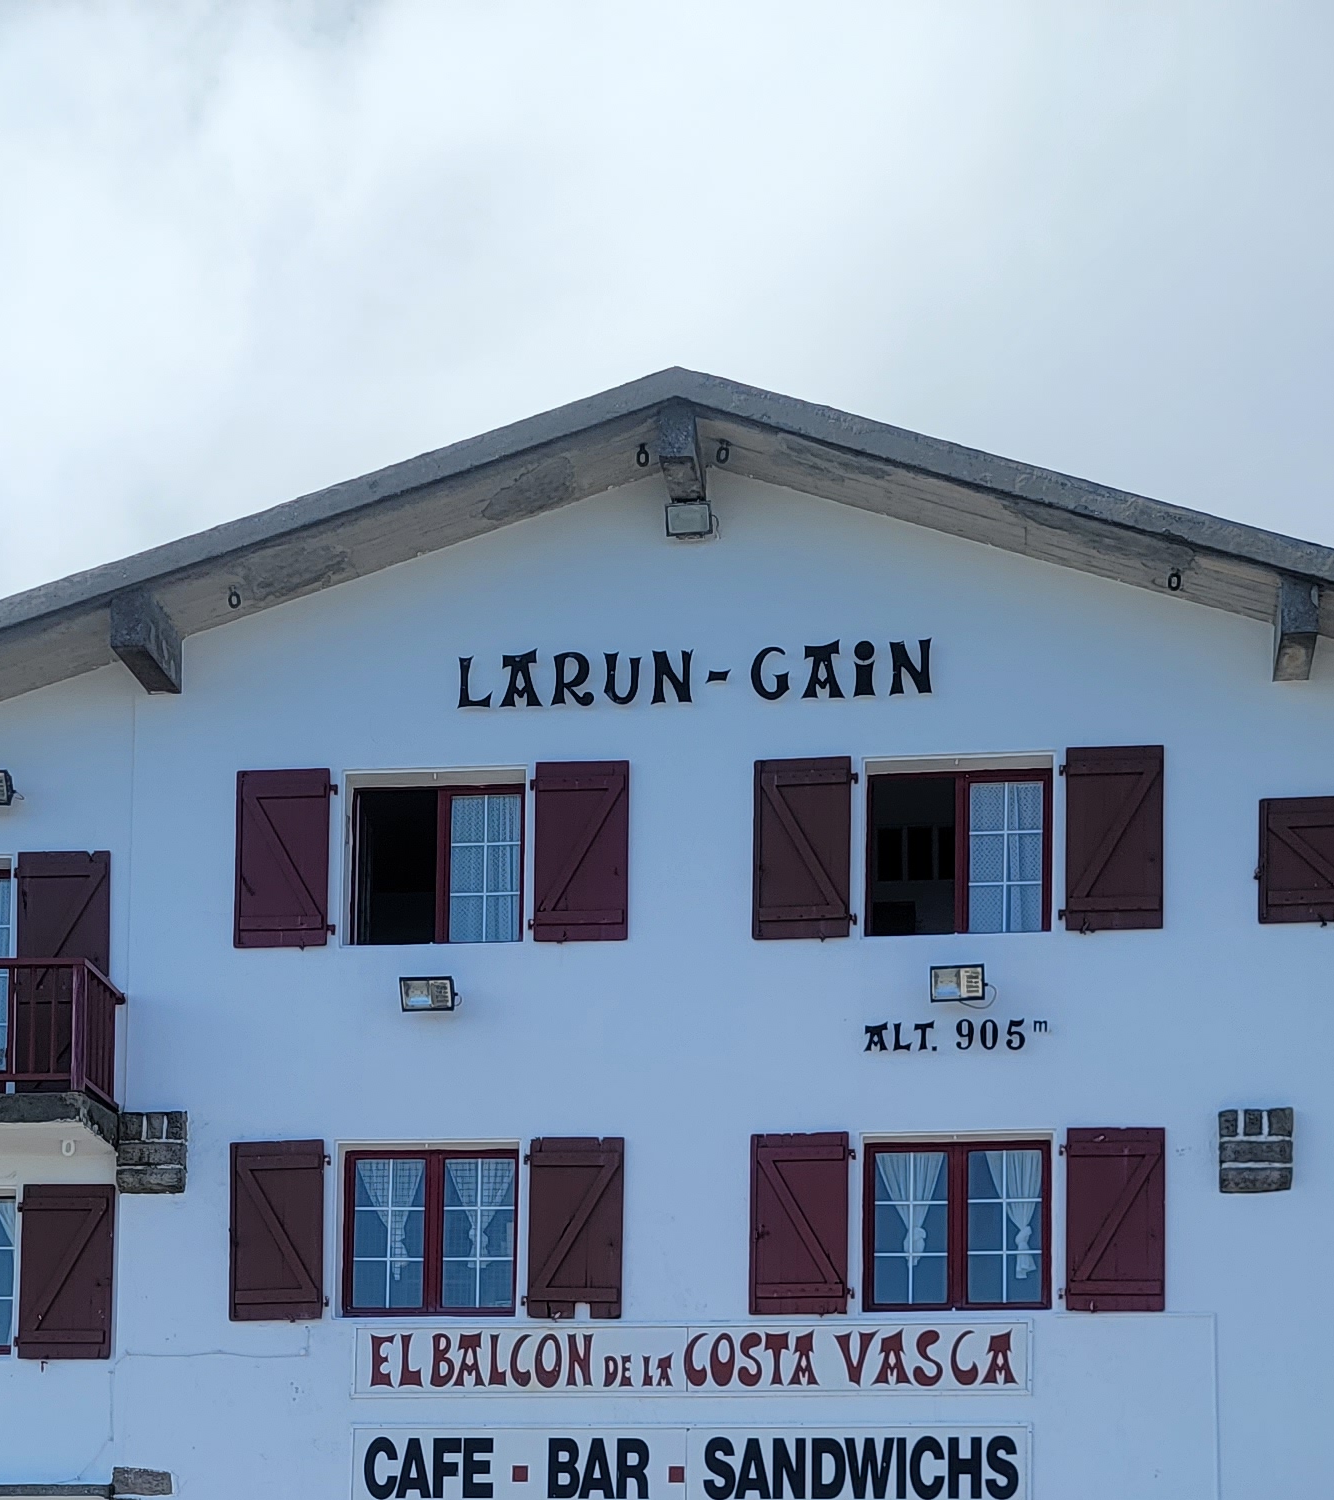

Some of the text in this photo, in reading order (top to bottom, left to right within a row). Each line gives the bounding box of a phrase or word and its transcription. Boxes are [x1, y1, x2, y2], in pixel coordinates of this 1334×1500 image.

[865, 1021, 937, 1051] ALT.
[370, 1327, 1017, 1388] EL BALCON DE LA COSTA VASCA
[364, 1436, 1018, 1500] CAFE BAR SANDWICHS
